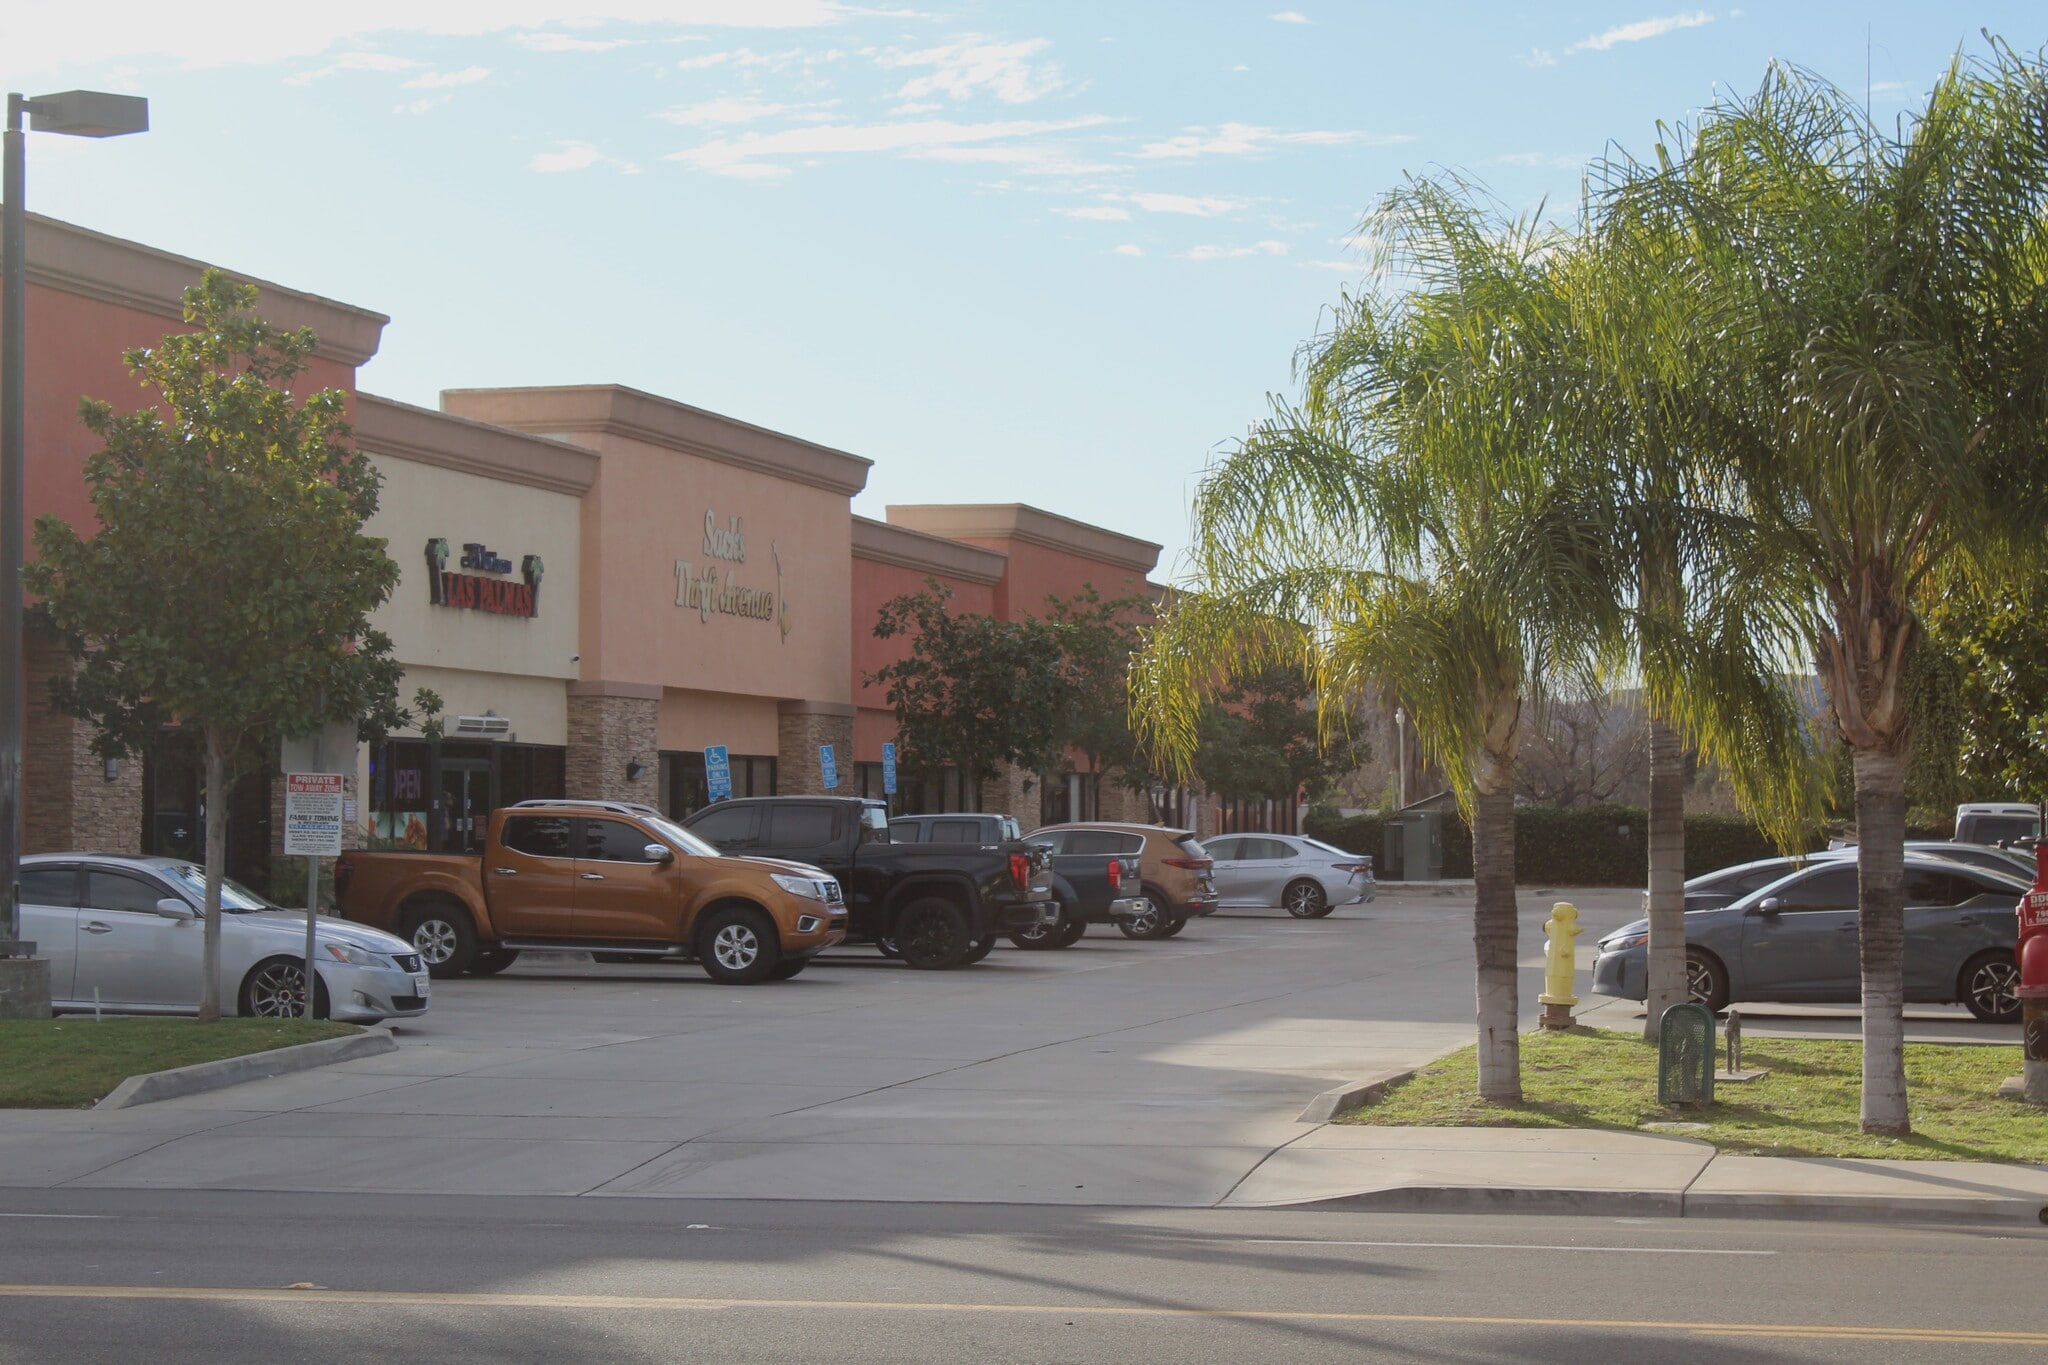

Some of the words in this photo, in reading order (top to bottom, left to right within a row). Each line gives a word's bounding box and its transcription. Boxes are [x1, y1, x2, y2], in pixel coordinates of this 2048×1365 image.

[443, 571, 475, 609] LAS
[479, 576, 532, 617] PALMAS
[295, 775, 335, 785] PRIVATE
[290, 783, 304, 792] TOW
[305, 784, 323, 792] AWAY
[324, 784, 340, 793] ZONE
